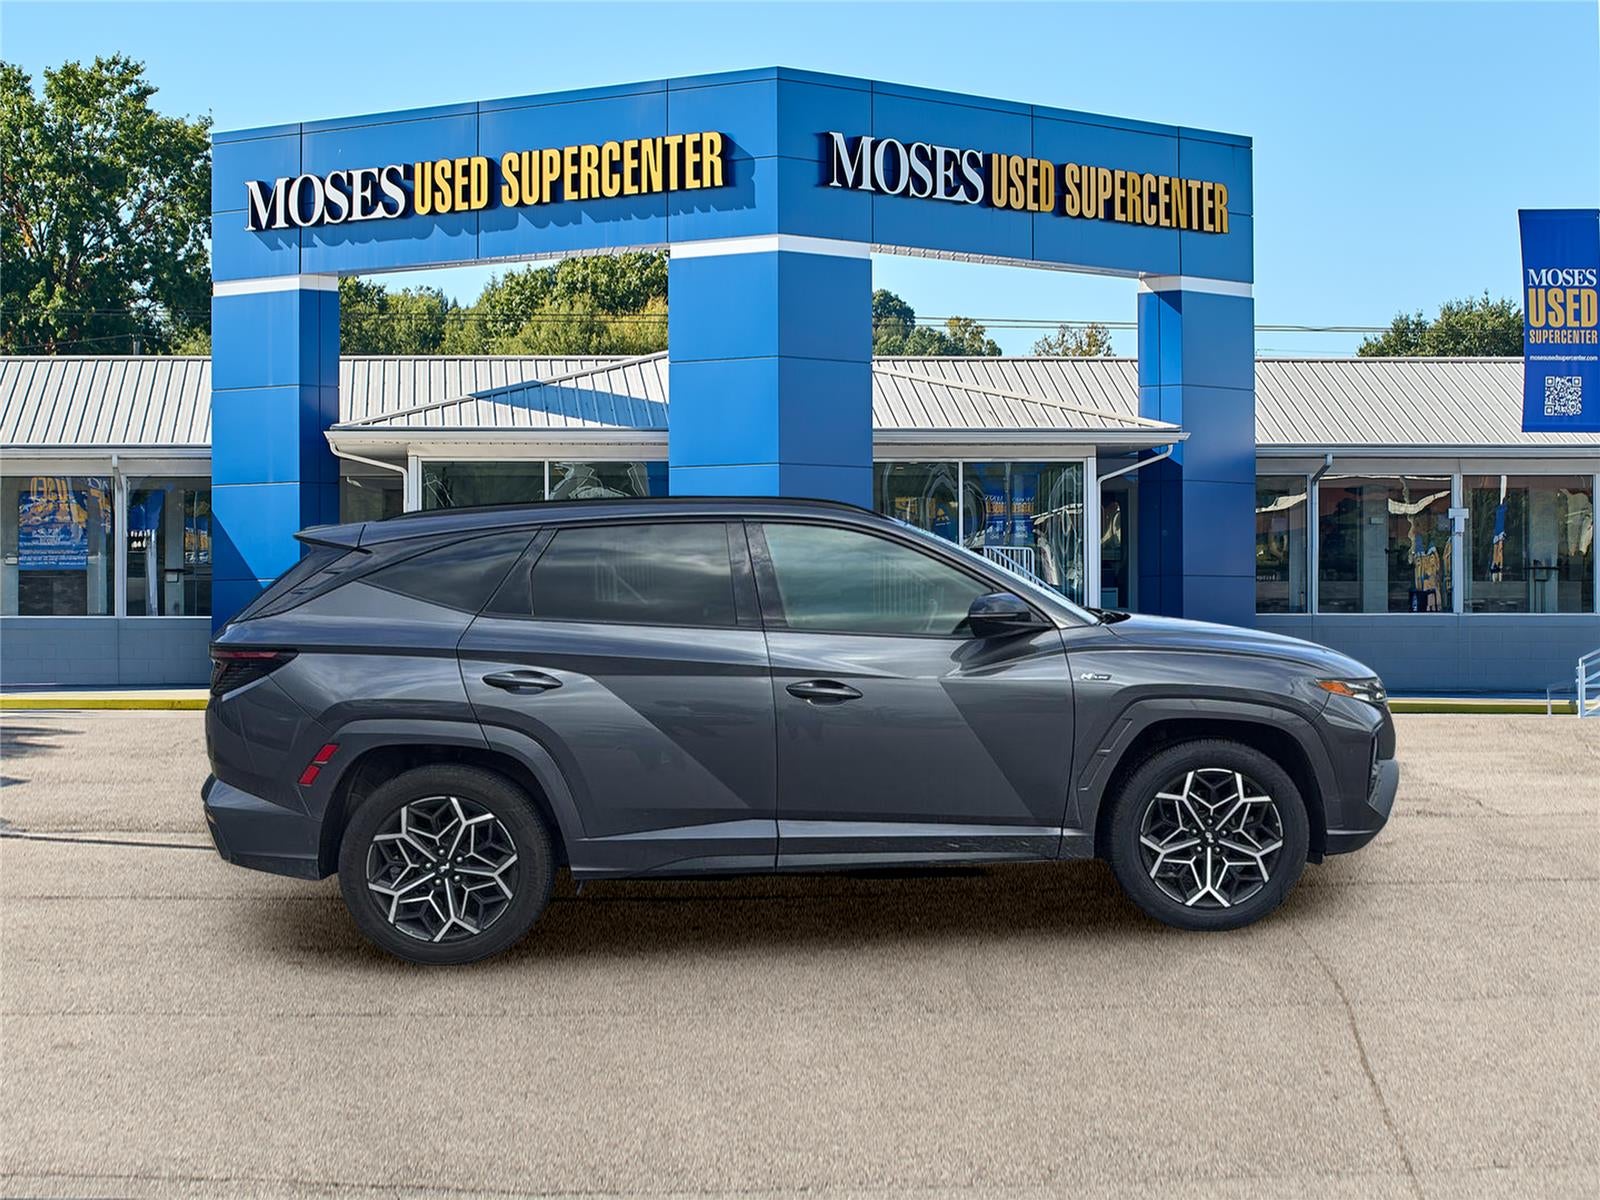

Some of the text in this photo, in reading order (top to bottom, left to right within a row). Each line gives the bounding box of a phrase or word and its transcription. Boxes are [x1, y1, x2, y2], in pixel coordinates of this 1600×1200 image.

[245, 131, 723, 231] MOSES USED SUPERCENTER
[829, 132, 1229, 233] MOSES USED SUPERCENTER
[1527, 268, 1597, 287] MOSES
[1528, 288, 1598, 327] USED
[1529, 329, 1598, 344] SUPERCENTER
